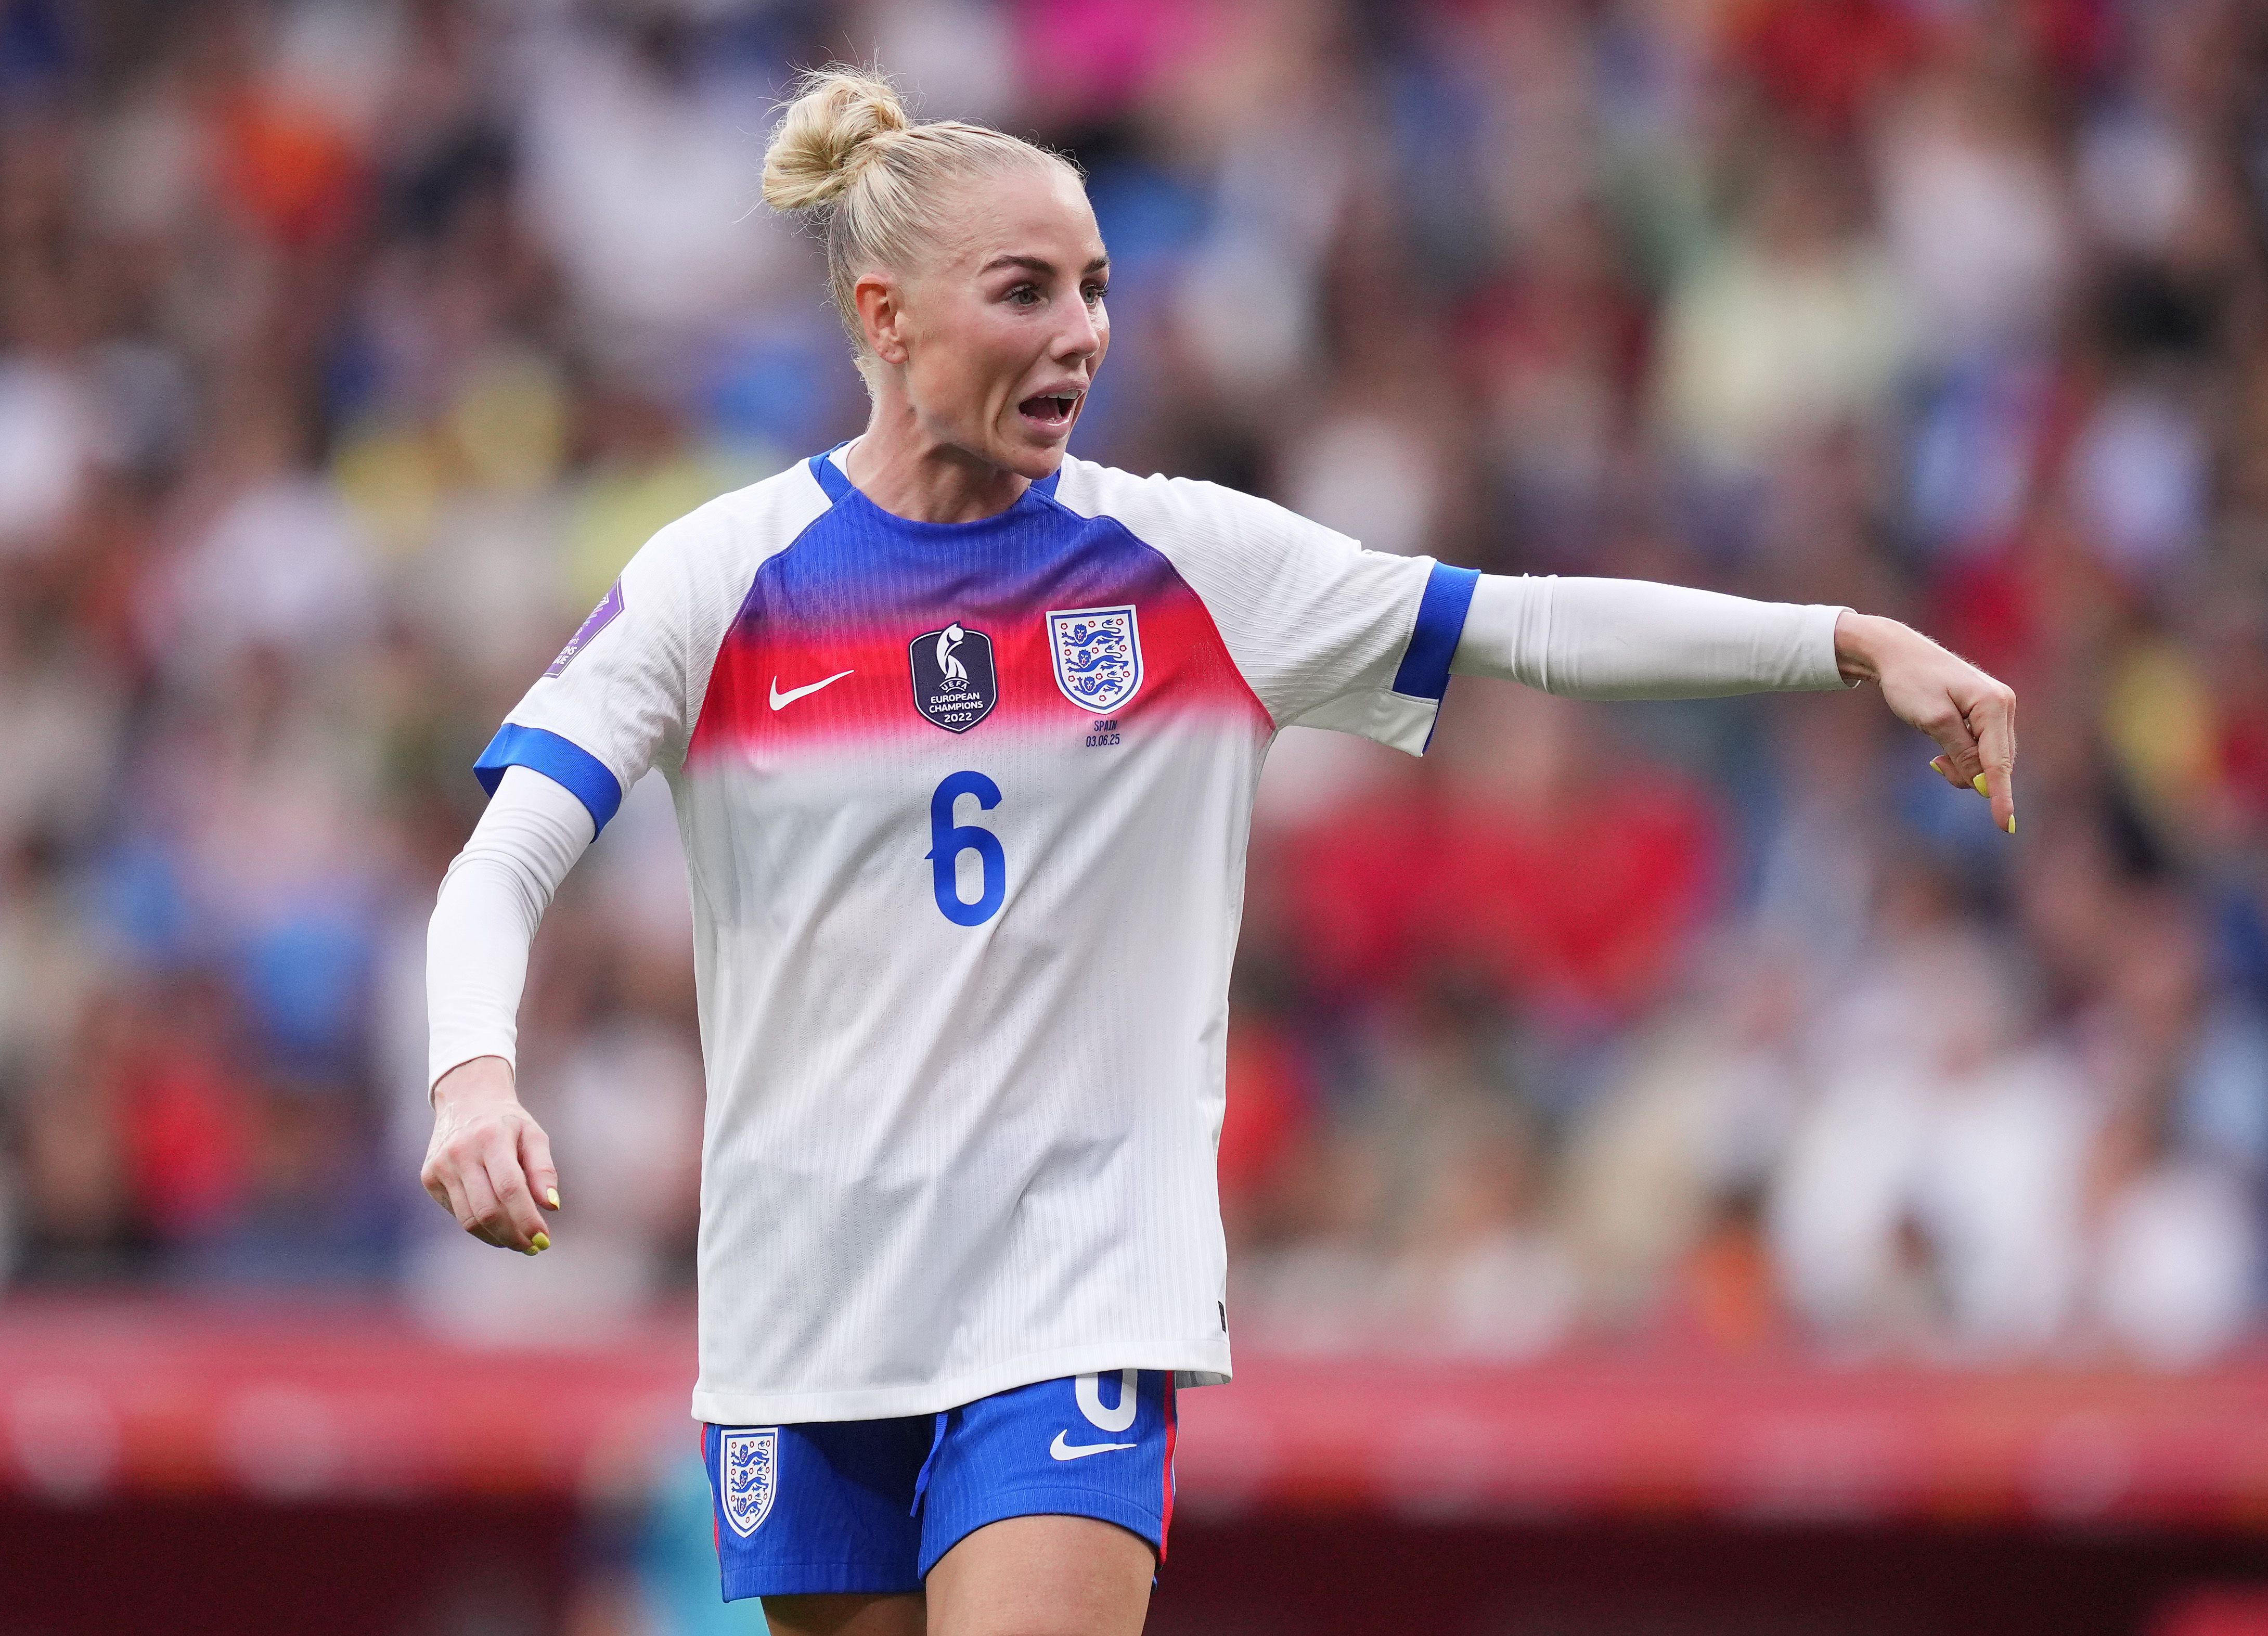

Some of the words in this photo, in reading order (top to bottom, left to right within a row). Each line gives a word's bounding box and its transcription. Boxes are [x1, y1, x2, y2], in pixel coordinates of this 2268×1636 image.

[941, 681, 967, 691] UEFA
[930, 692, 980, 704] EUROPEAN
[929, 701, 984, 713] CHAMPIONS
[944, 712, 972, 723] 2022
[1094, 720, 1118, 731] SPAIN
[1086, 733, 1120, 747] 03.06.25
[924, 770, 1006, 926] 6
